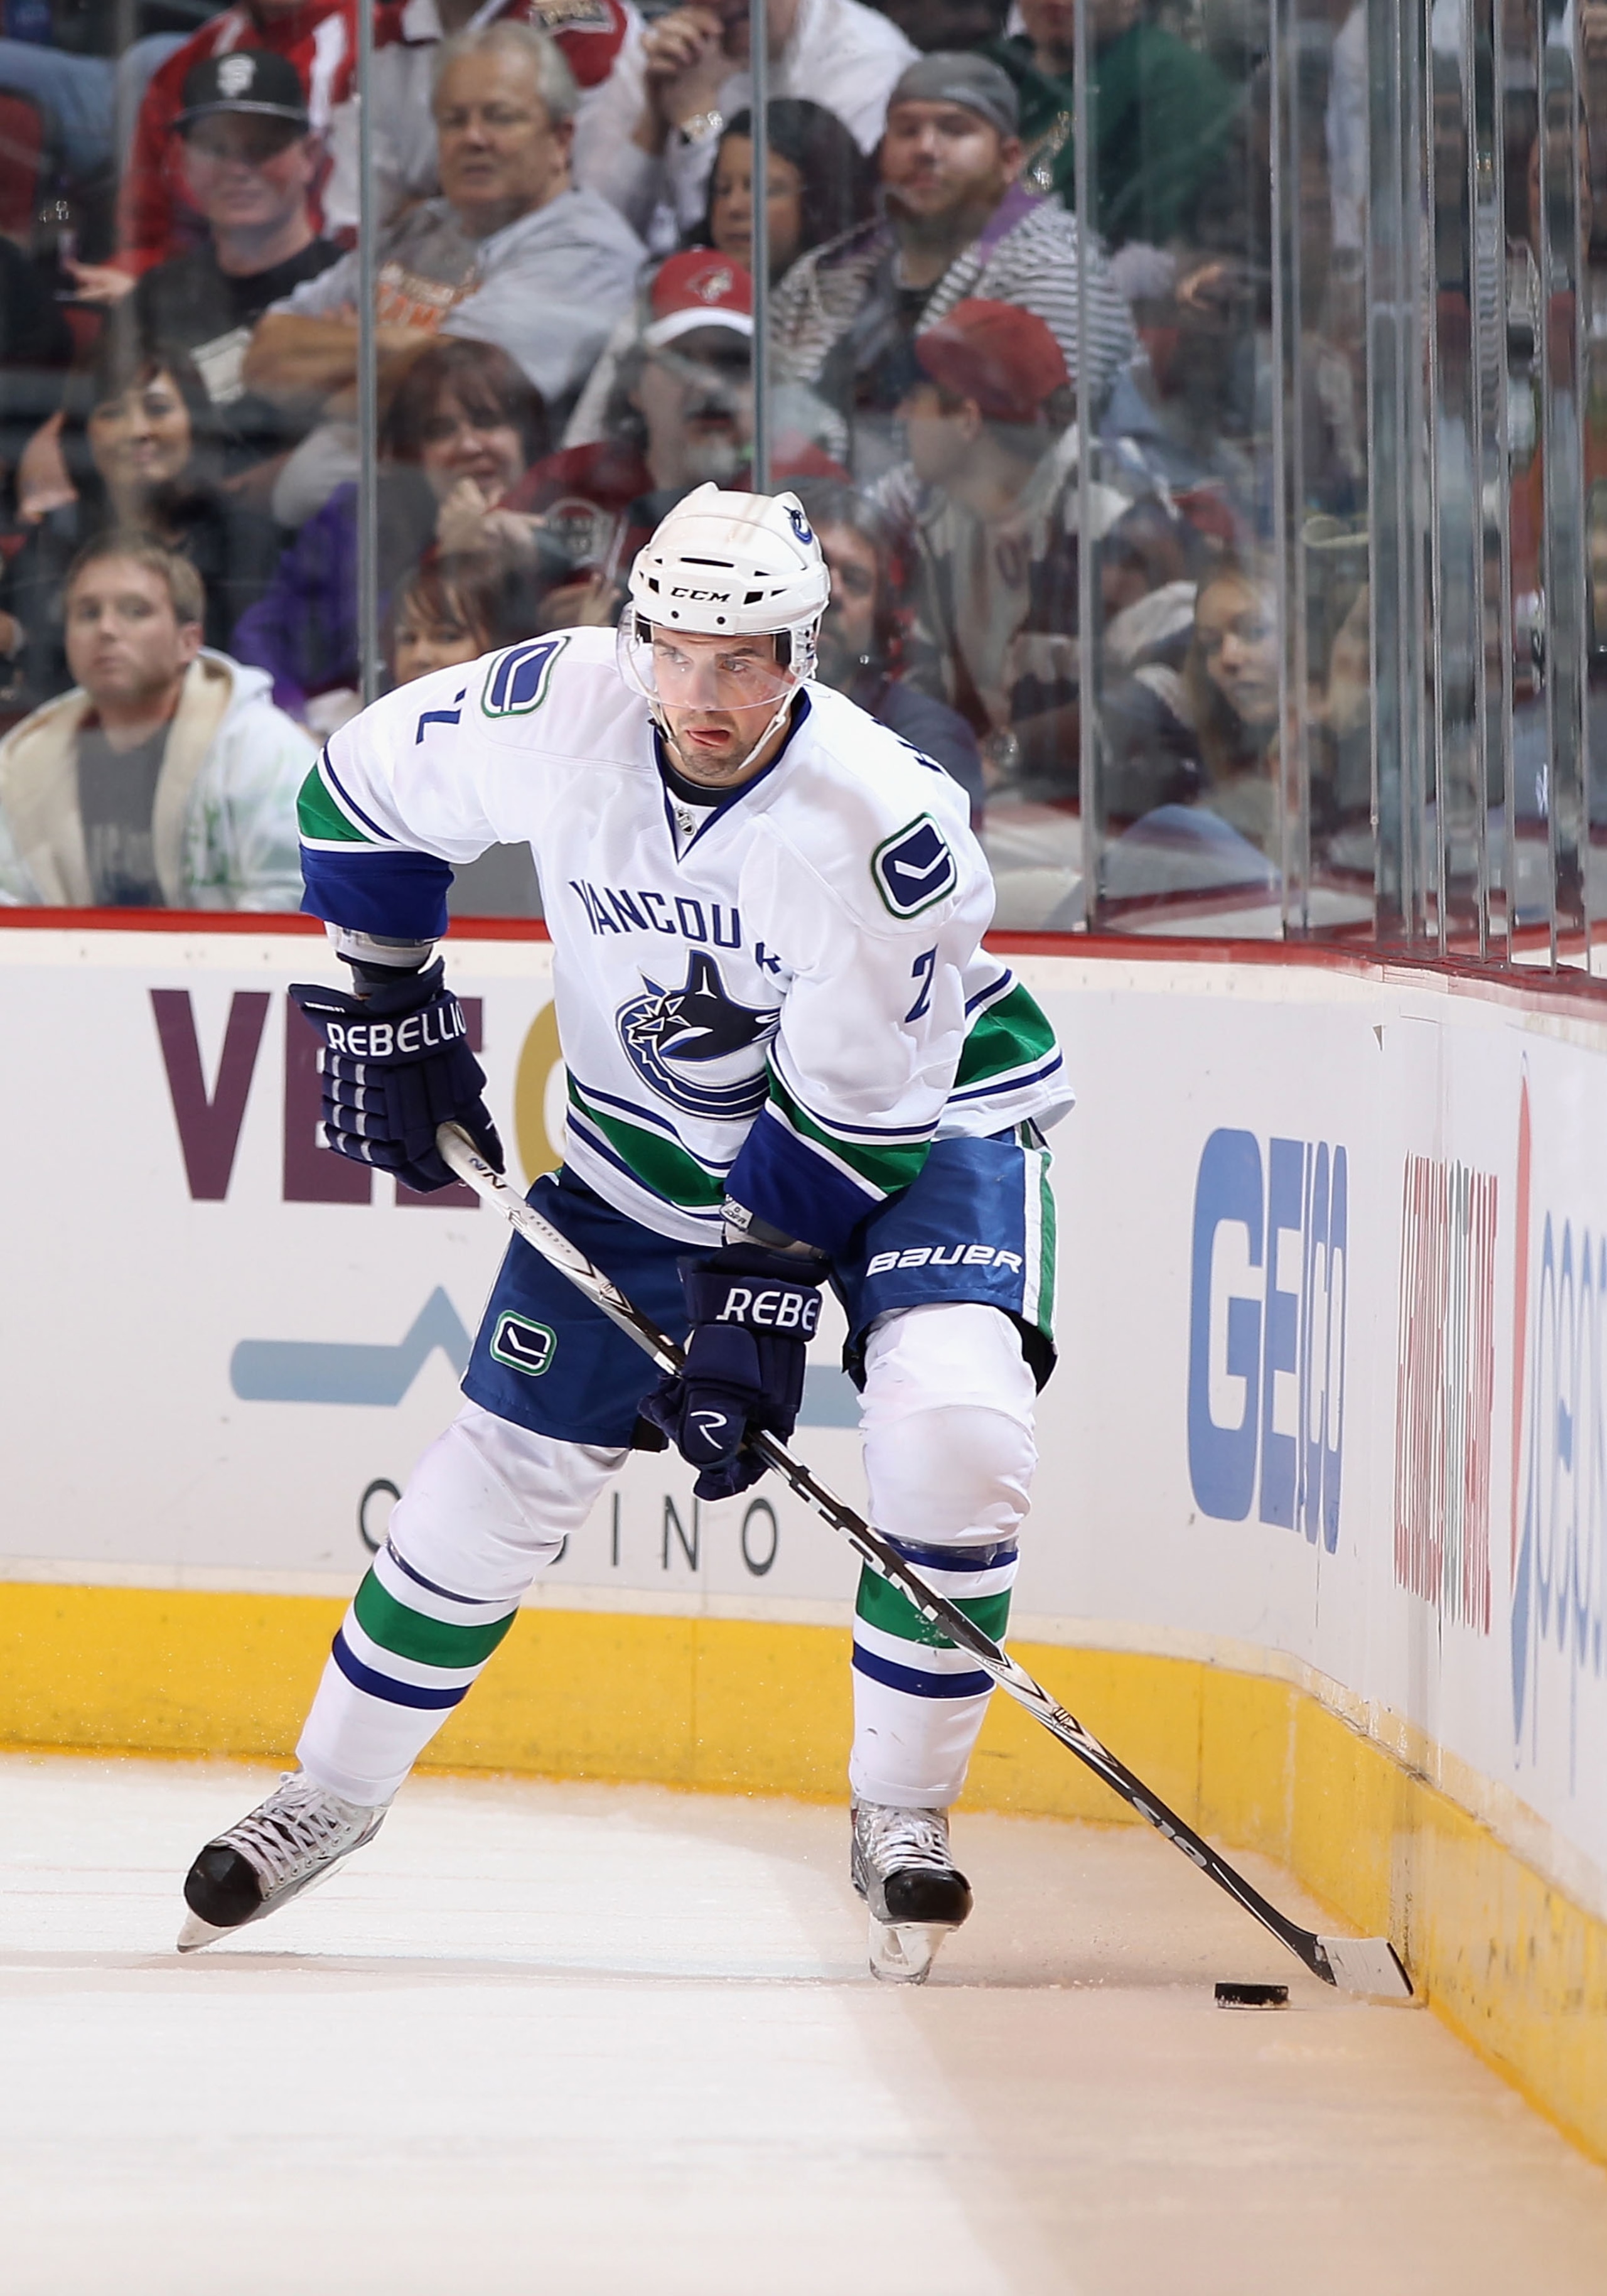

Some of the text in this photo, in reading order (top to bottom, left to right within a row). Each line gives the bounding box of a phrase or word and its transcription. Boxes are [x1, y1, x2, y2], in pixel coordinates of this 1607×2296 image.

[670, 586, 731, 602] CCM
[1187, 1127, 1348, 1555] GEICO
[356, 1478, 778, 1576] CINO
